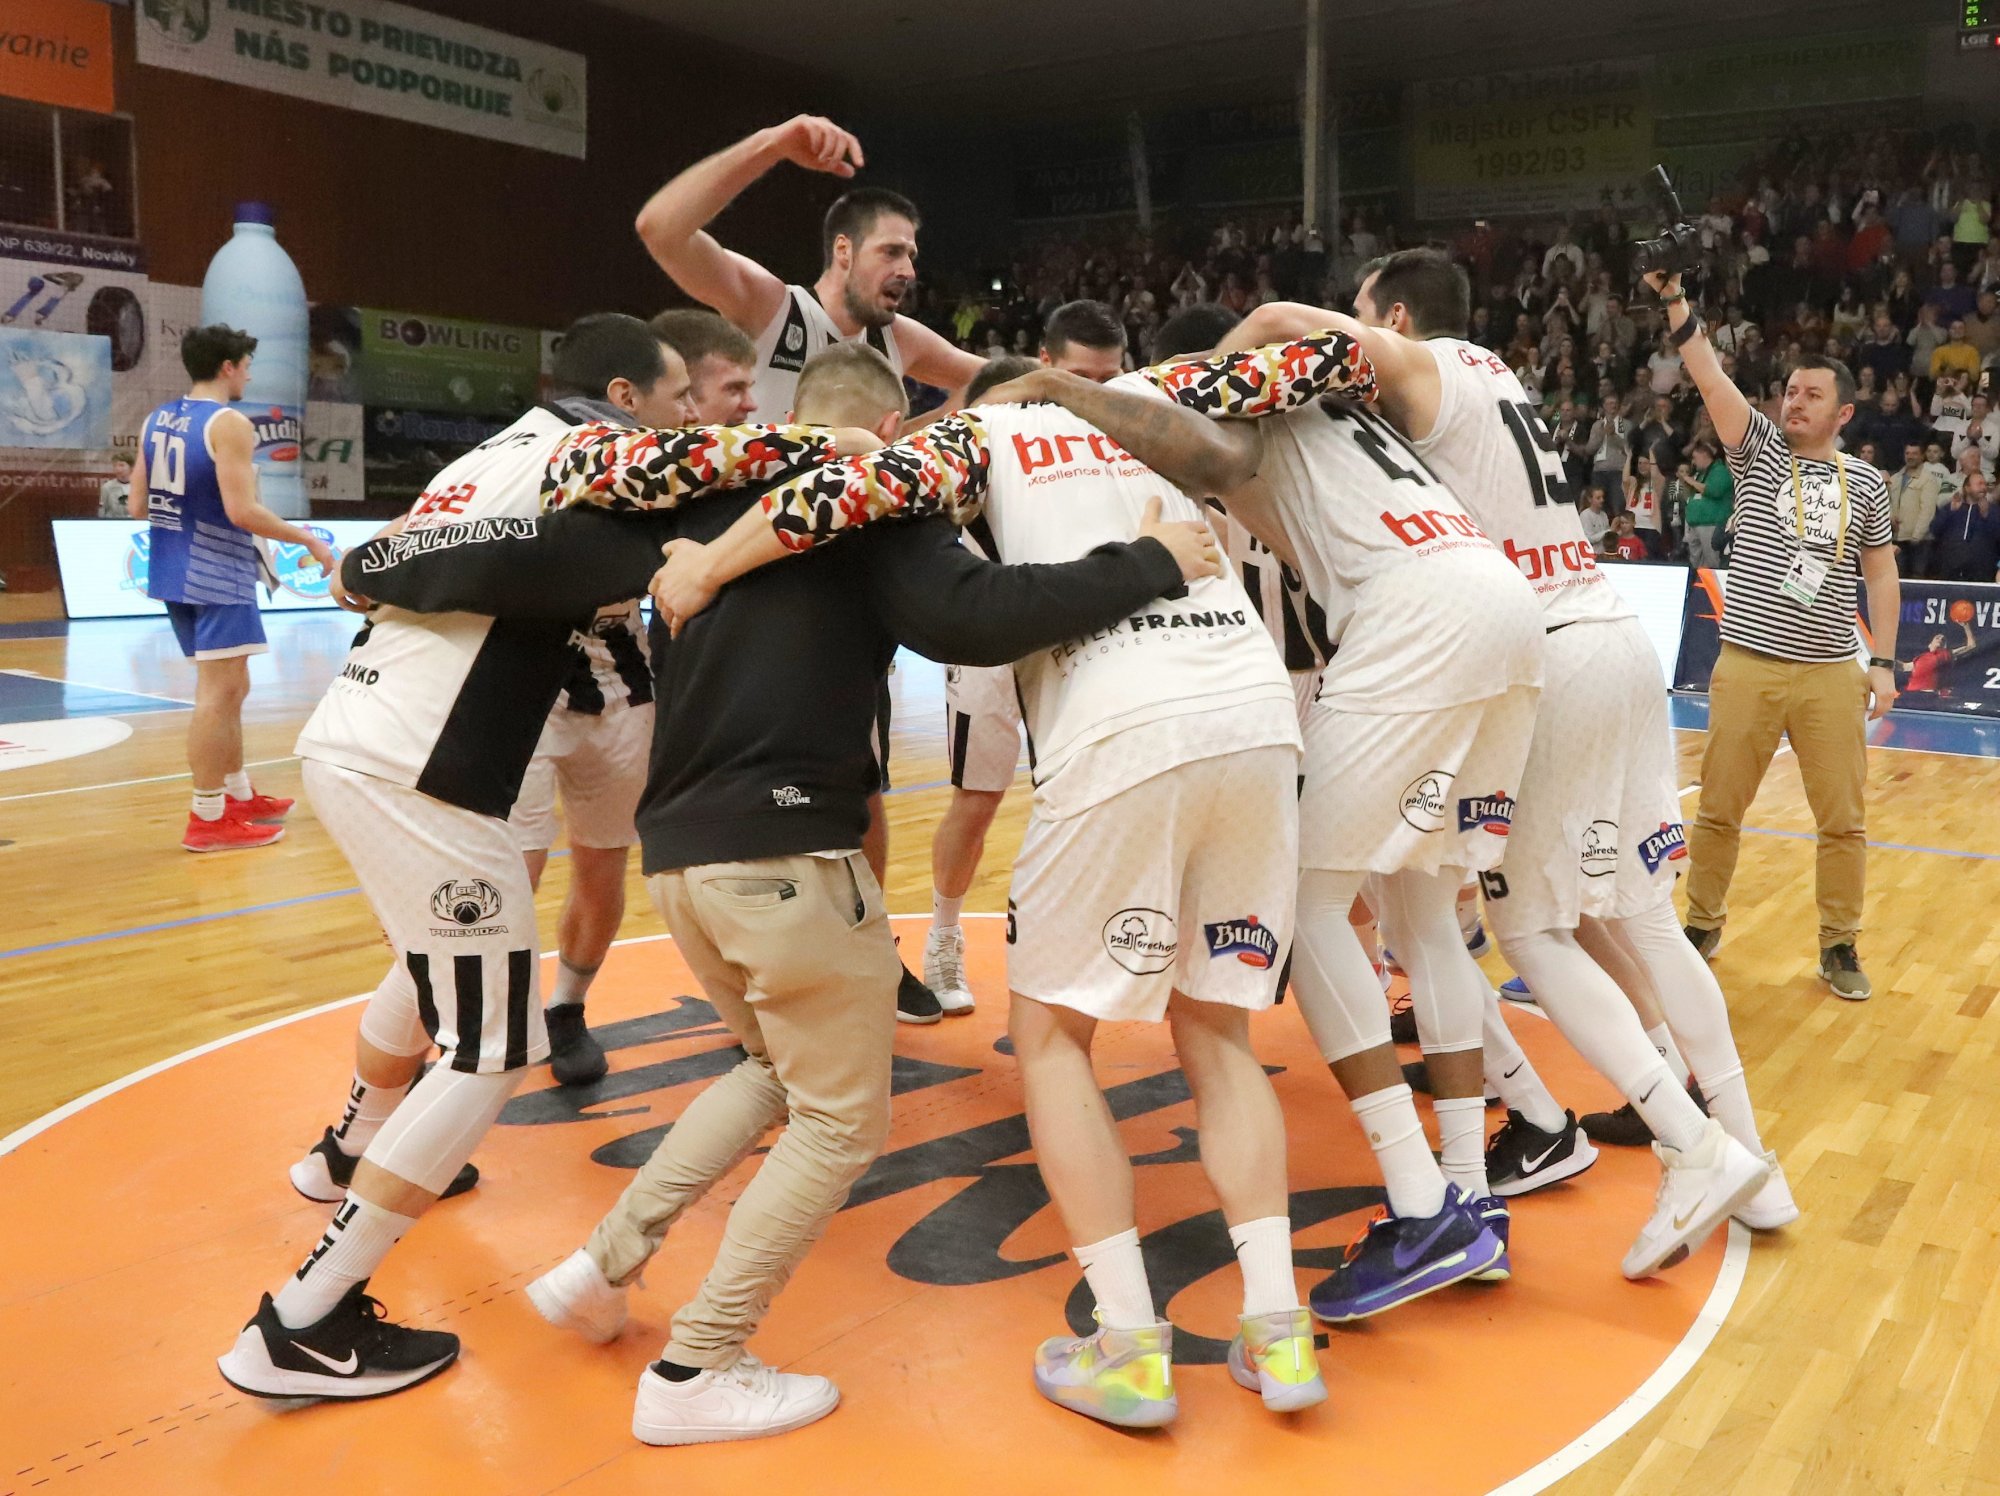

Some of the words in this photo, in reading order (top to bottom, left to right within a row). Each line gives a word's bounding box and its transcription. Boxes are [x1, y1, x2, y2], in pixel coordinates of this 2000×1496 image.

[360, 17, 522, 81] PRIEVIDZA
[234, 27, 311, 71] NÁS
[328, 52, 512, 117] PODPORUJE
[1428, 116, 1537, 148] Majster
[1473, 145, 1587, 178] 1992/93
[82, 246, 137, 266] Nováky
[380, 318, 521, 354] BOWLING
[149, 431, 186, 496] 10
[1499, 399, 1578, 506] 15
[1028, 466, 1101, 488] xcellence
[1129, 610, 1246, 632] FRANKO
[1463, 800, 1514, 823] Budi
[1645, 827, 1685, 864] Budi
[456, 886, 477, 895] BC
[429, 925, 509, 938] PRIEVIDZA
[1110, 934, 1130, 946] pod
